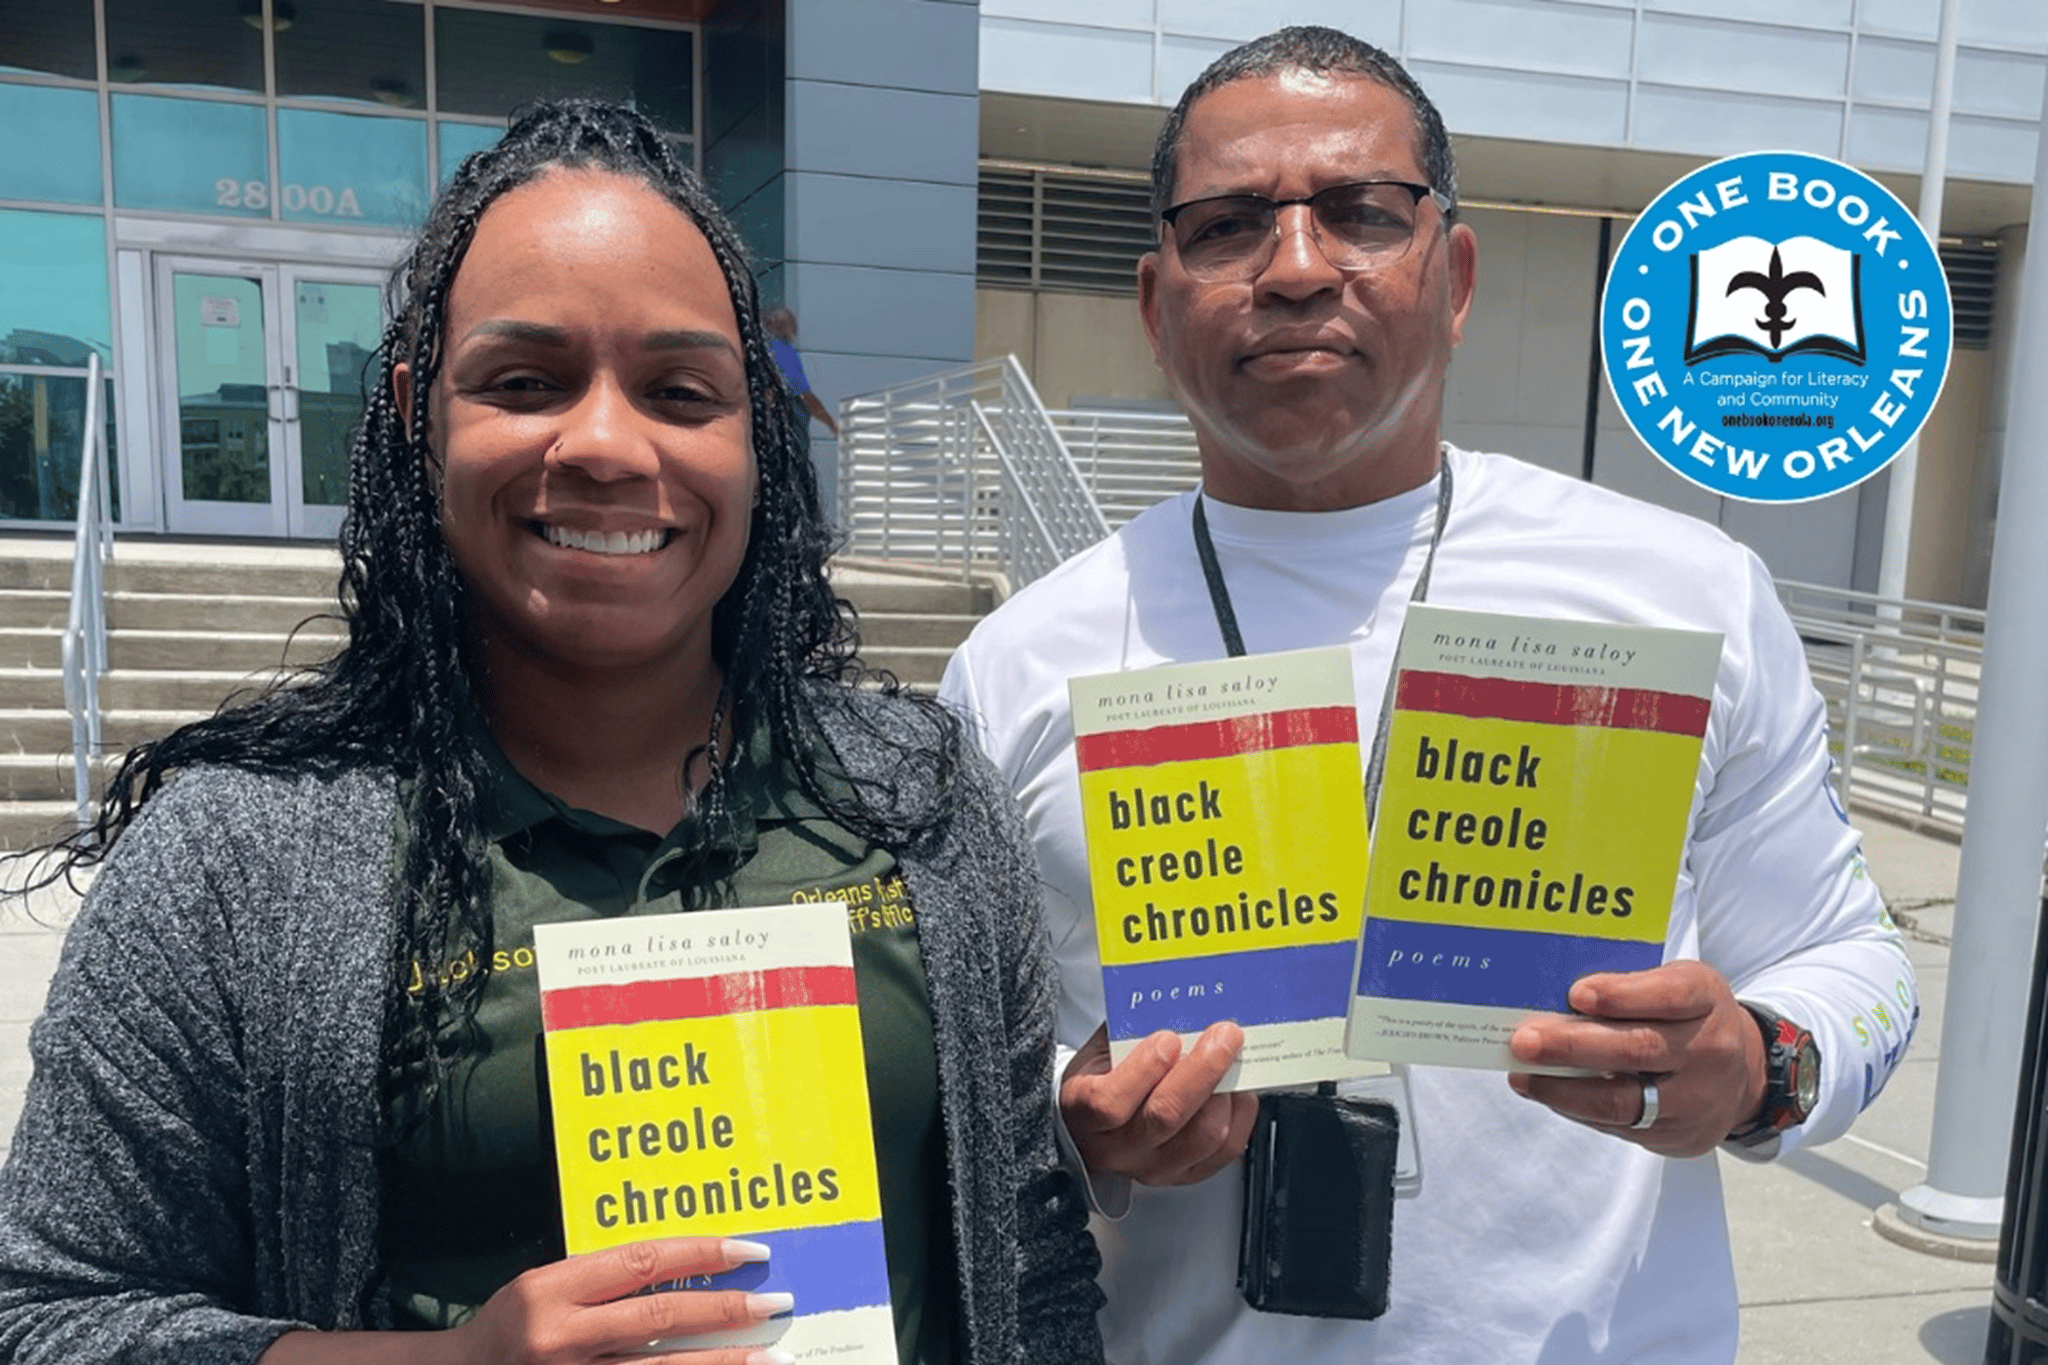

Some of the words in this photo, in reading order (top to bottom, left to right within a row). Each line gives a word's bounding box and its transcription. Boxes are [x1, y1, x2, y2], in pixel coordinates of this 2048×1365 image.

[215, 178, 363, 217] 2800A
[1433, 633, 1497, 651] mona
[1511, 635, 1557, 656] lisa
[1572, 642, 1636, 667] saloy
[1438, 653, 1466, 664] POET
[1470, 656, 1525, 670] LAUREATE
[1529, 661, 1544, 671] OF
[1098, 690, 1153, 708] mona
[1166, 683, 1207, 700] lisa
[1220, 674, 1277, 693] saloy
[1417, 736, 1540, 788] black
[1110, 782, 1222, 829] black
[1408, 806, 1547, 852] creole
[1117, 838, 1243, 887] creole
[1399, 861, 1634, 919] chronicles
[1123, 889, 1340, 945] chronicles
[568, 943, 632, 960] mona
[648, 935, 692, 953] lisa
[707, 928, 769, 950] saloy
[577, 965, 605, 976] POET
[609, 959, 666, 973] LAUREATE
[669, 957, 684, 968] OF
[1387, 949, 1491, 970] poems
[1130, 981, 1224, 1010] poems
[580, 1042, 710, 1097] black
[589, 1106, 734, 1163] creole
[595, 1162, 840, 1229] chronicles
